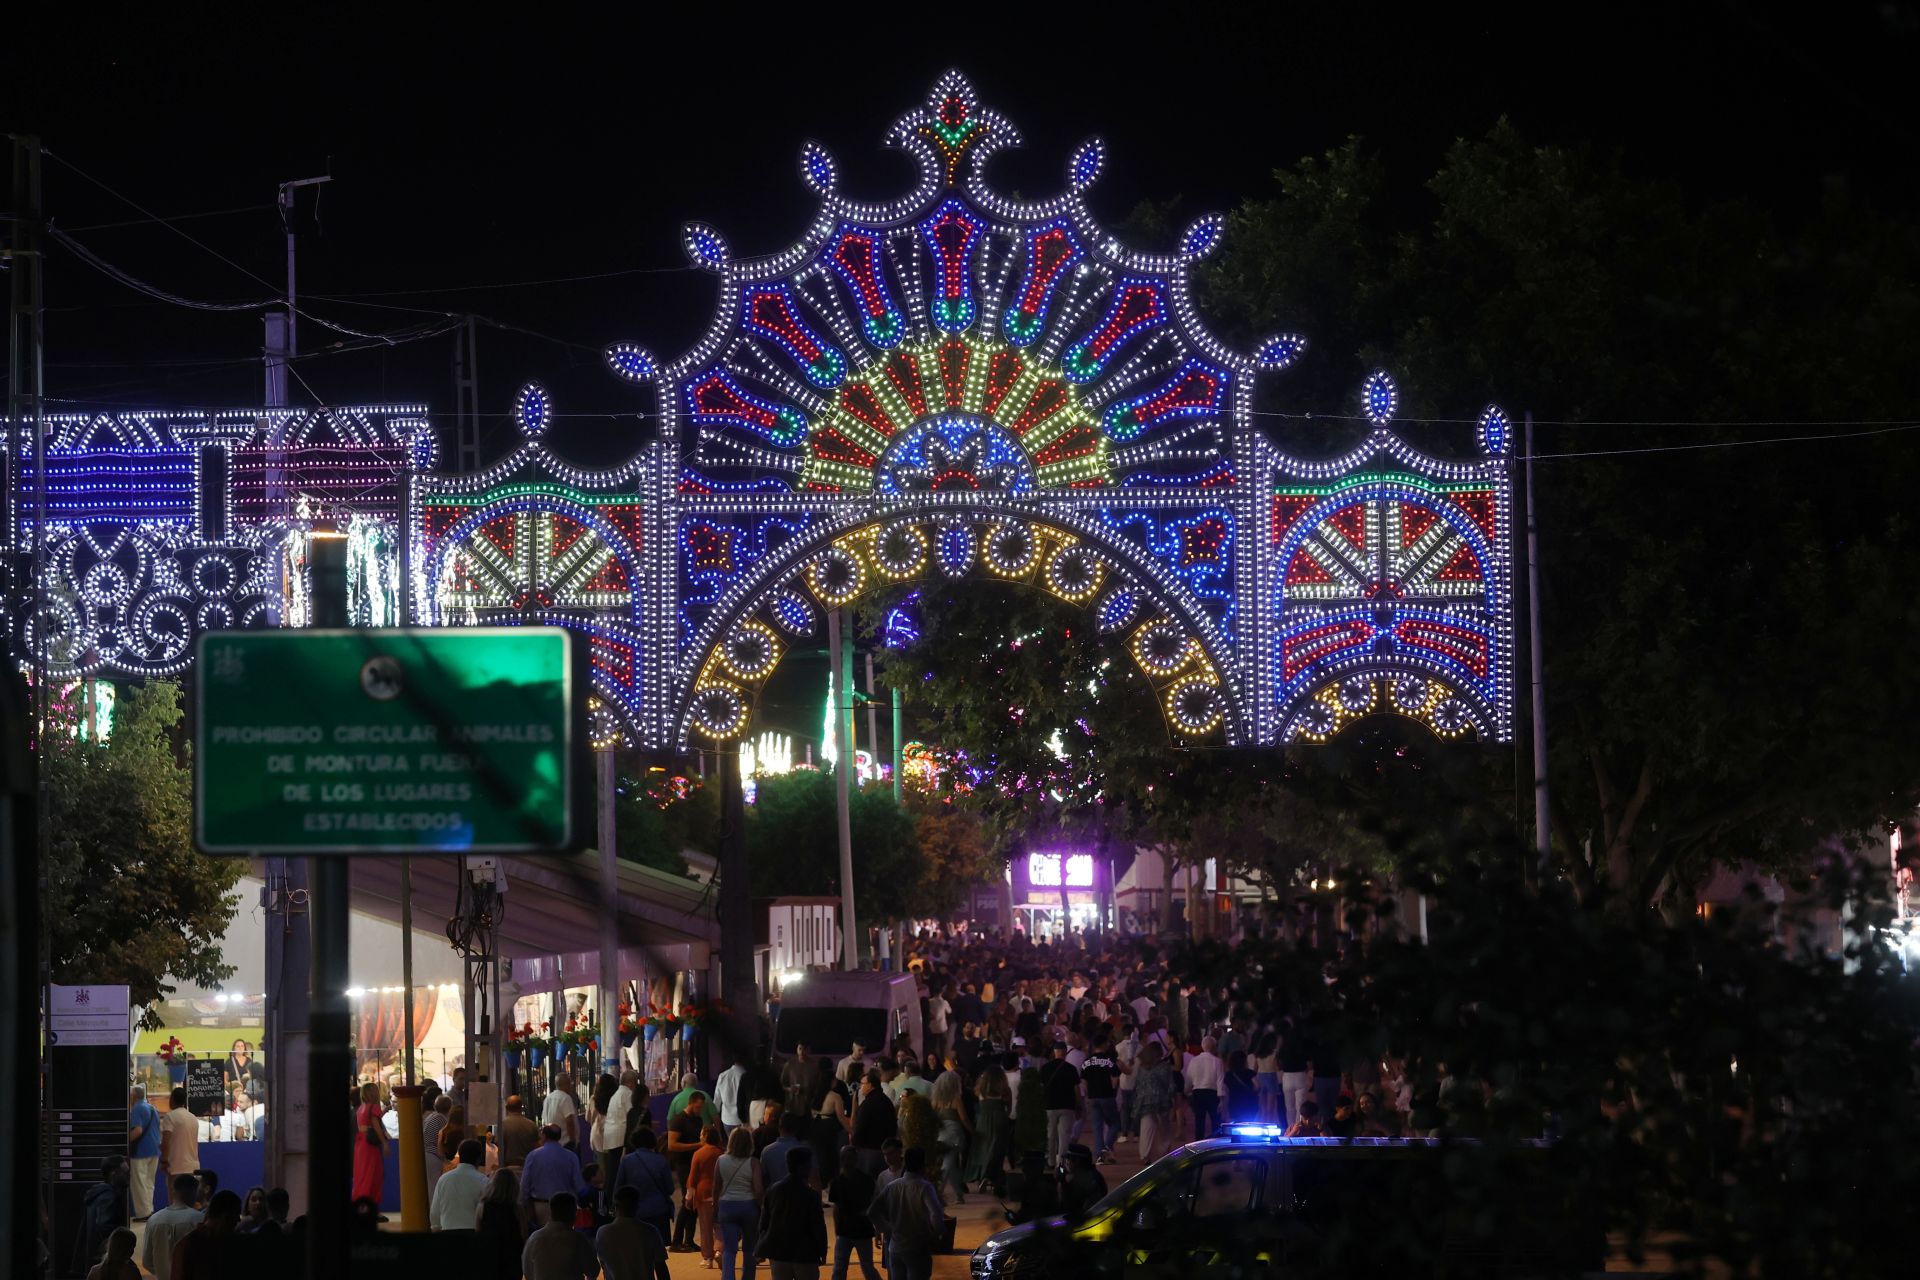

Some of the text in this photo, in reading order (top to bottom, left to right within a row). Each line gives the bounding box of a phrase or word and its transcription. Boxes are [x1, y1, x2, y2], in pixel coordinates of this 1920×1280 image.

[212, 725, 323, 744] PROHIBIDO
[334, 724, 437, 743] CIRCULAR
[267, 754, 295, 773] DE
[305, 754, 408, 773] MONTURA
[283, 783, 471, 802] DE LOS LUGARES
[304, 812, 463, 832] ESTABLECIDOS
